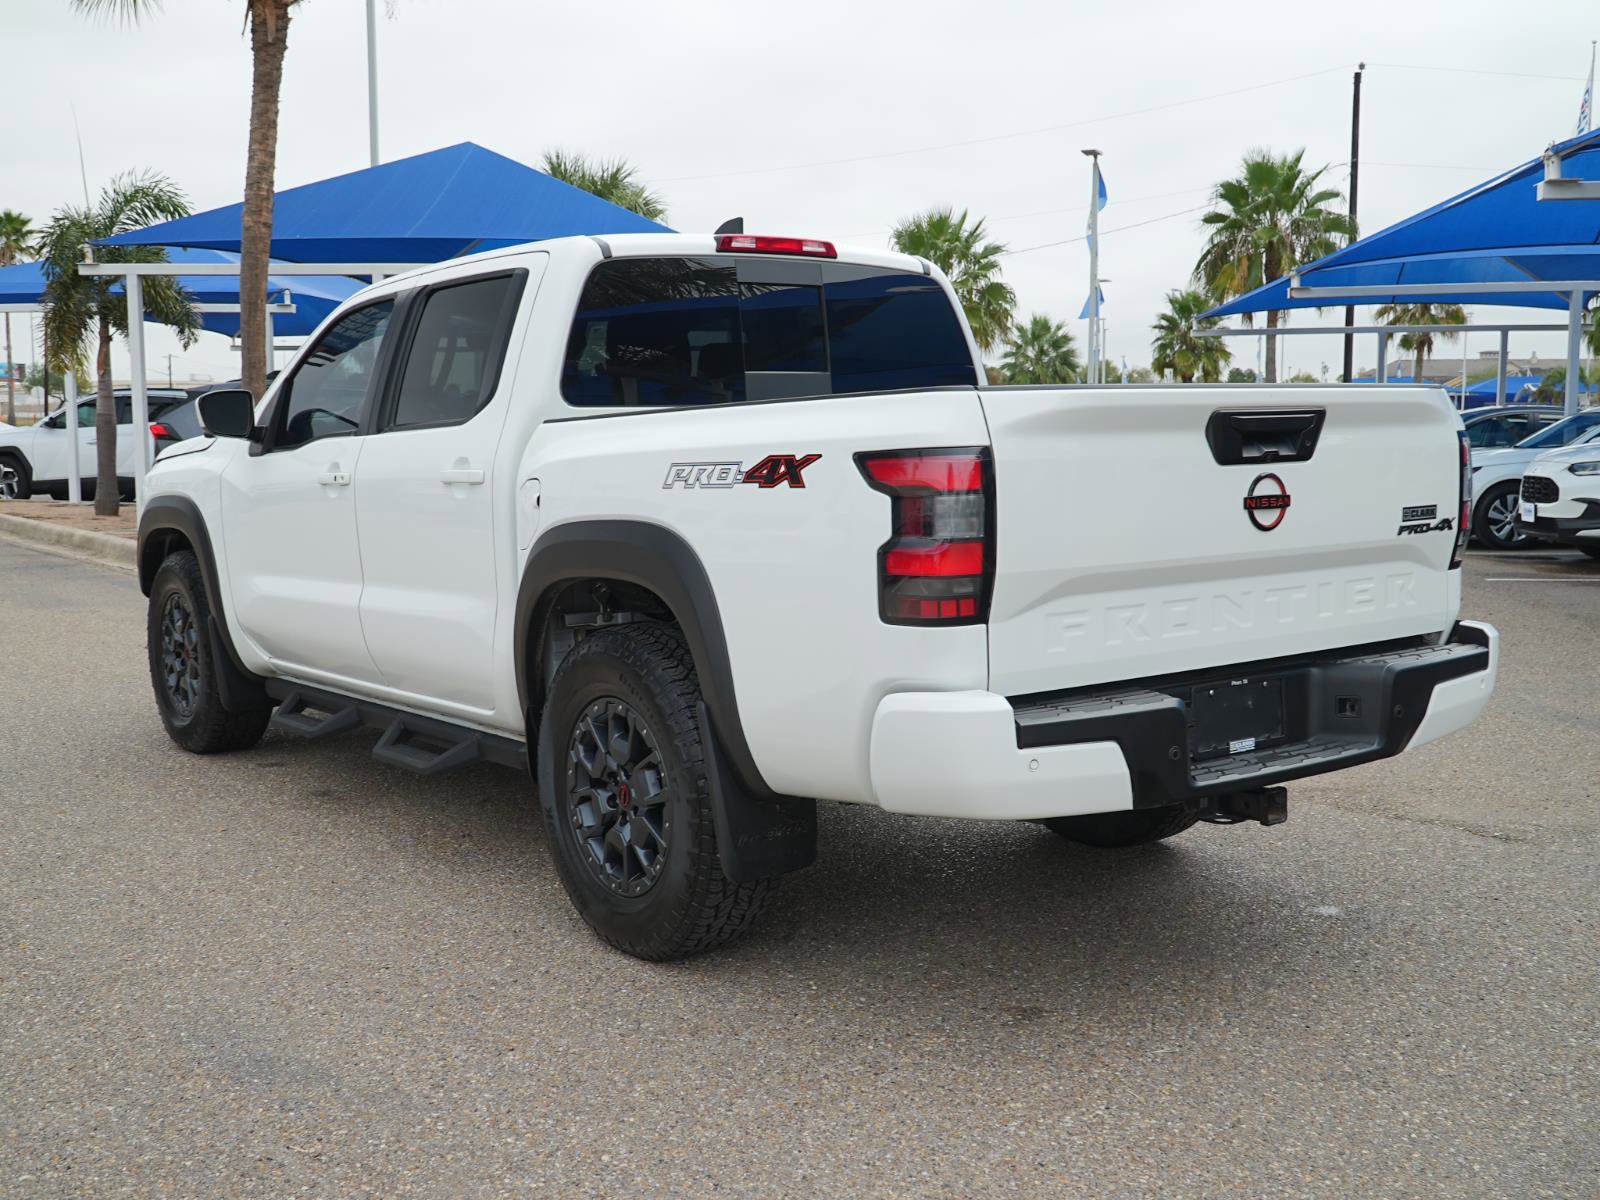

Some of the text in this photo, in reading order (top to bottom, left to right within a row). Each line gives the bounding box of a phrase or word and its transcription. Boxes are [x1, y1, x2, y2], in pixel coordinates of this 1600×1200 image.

[662, 454, 822, 489] PRO-4X
[1245, 495, 1291, 509] NISSAN
[1046, 586, 1417, 653] FRONTIER
